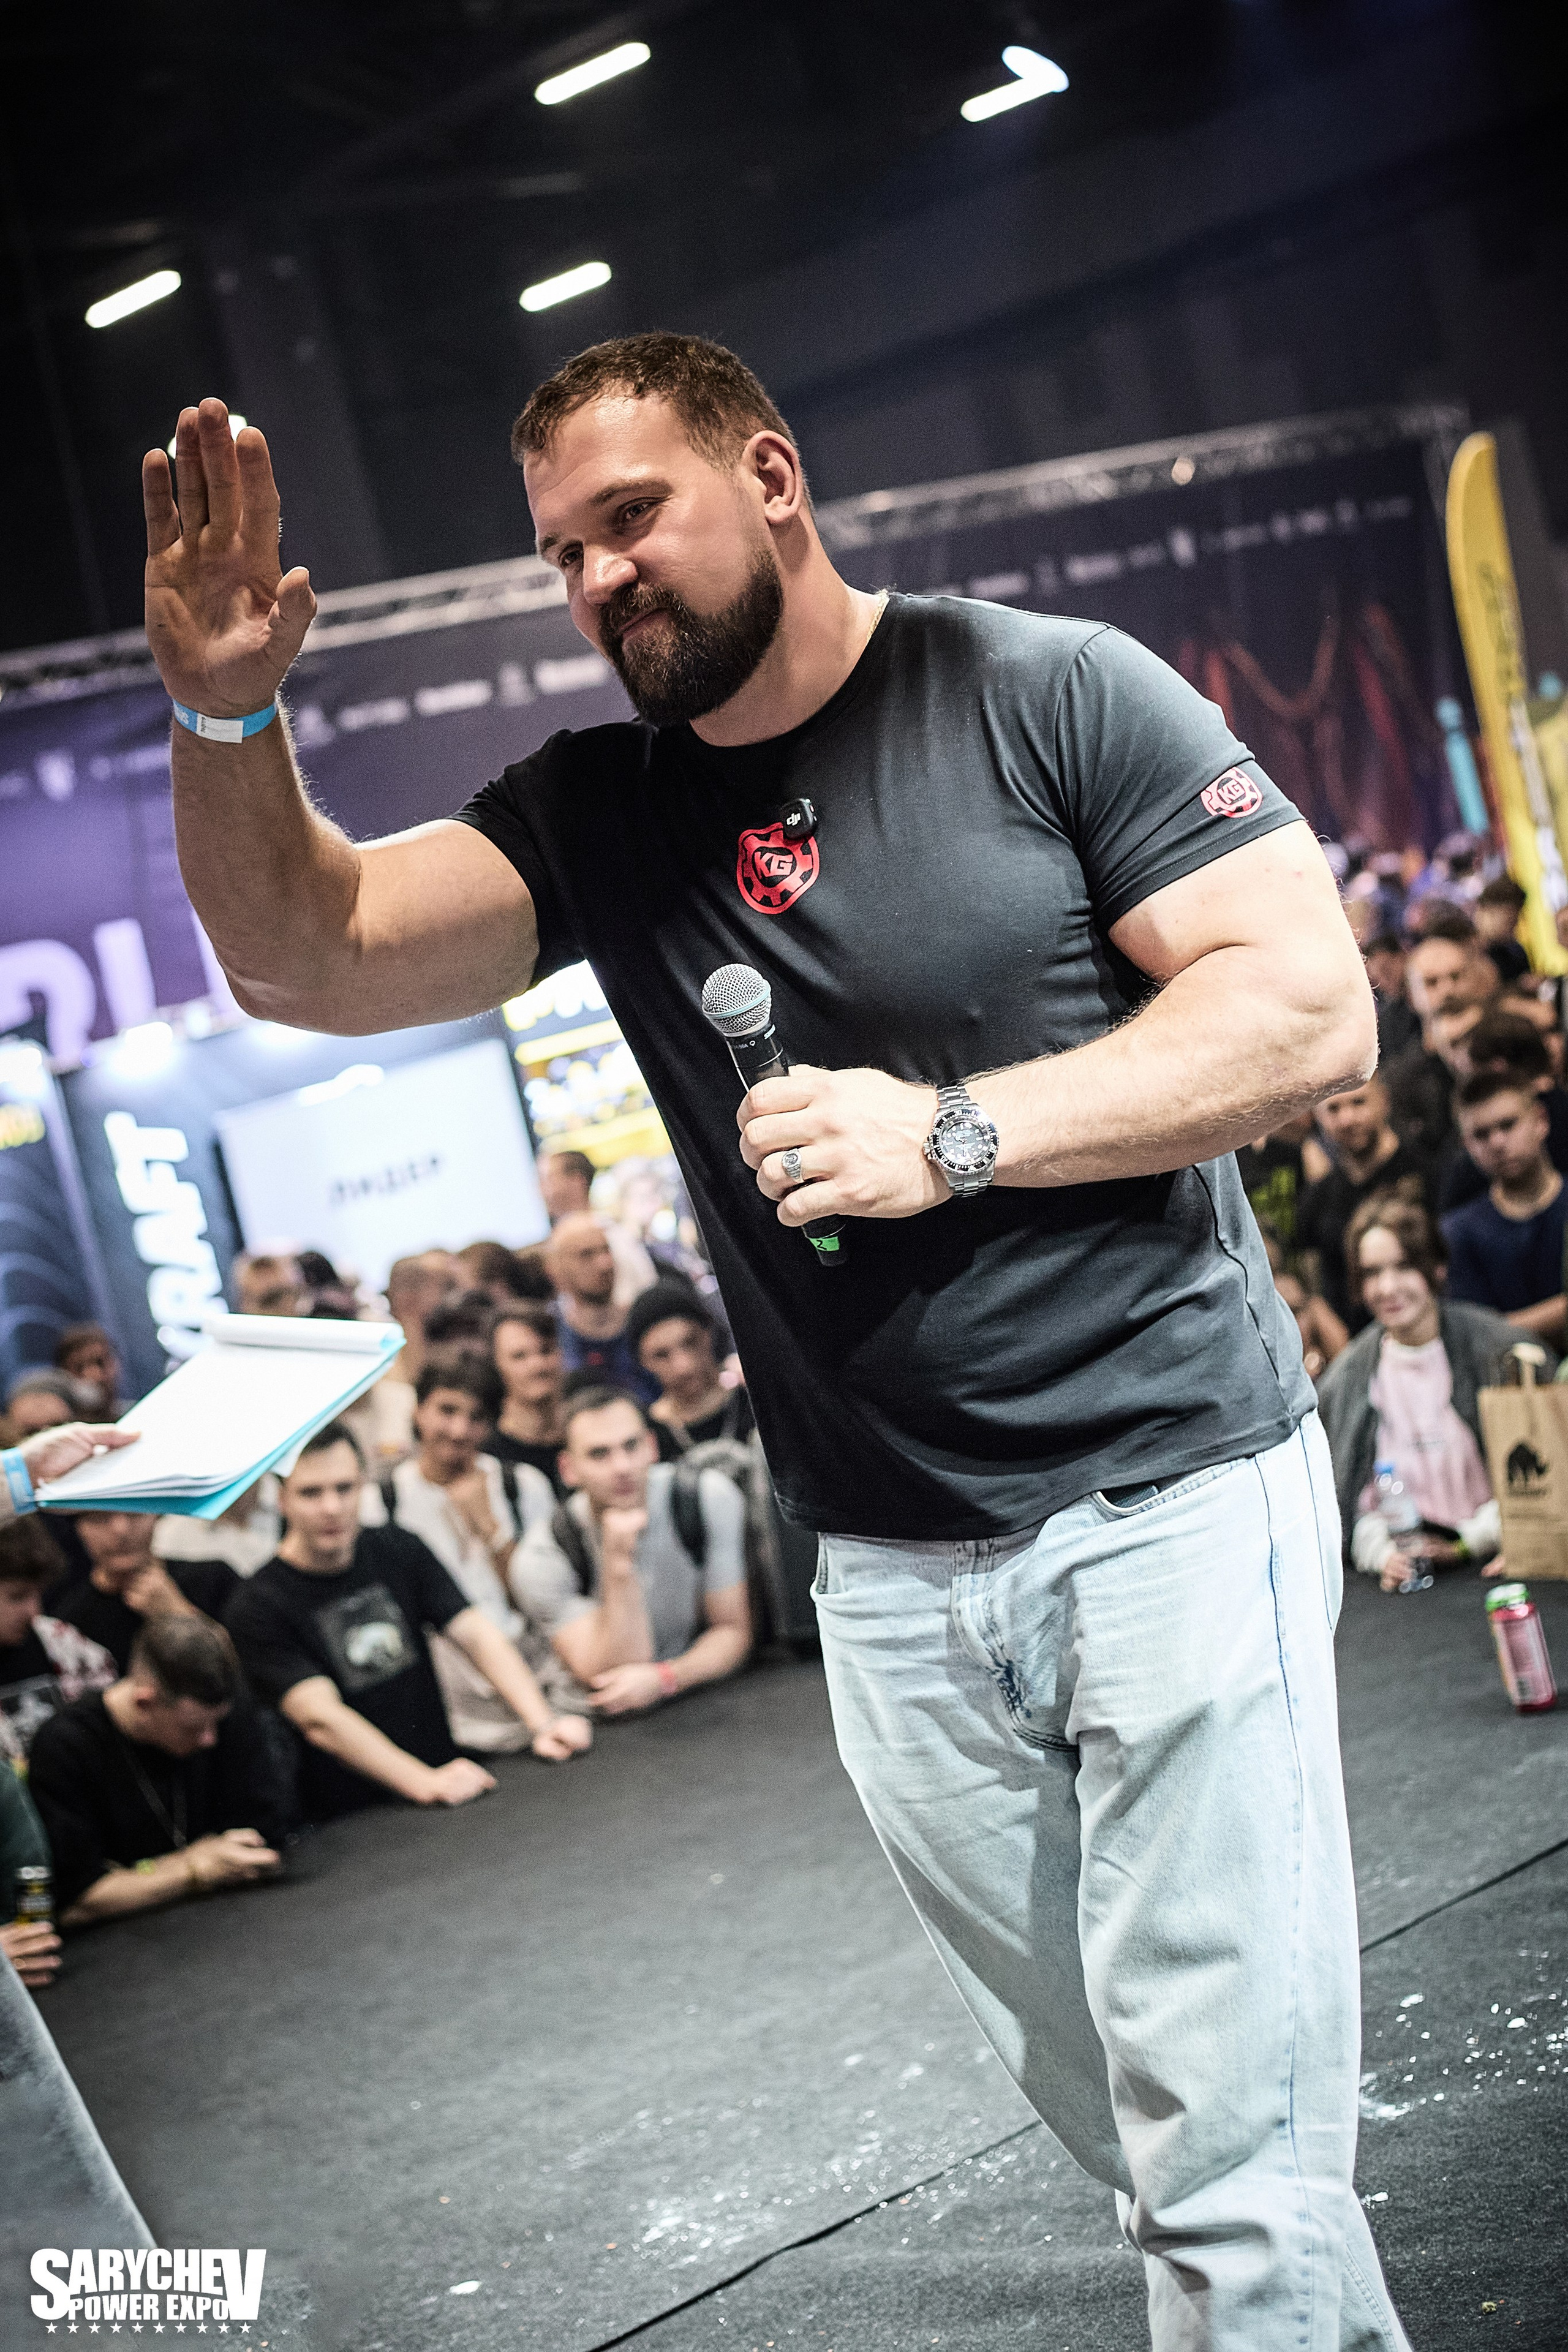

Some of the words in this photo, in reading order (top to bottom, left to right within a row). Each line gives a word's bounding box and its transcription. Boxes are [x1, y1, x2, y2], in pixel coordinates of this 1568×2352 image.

[1217, 779, 1245, 804] KG
[786, 813, 801, 826] dji
[754, 850, 793, 879] KG
[816, 1240, 827, 1250] 2
